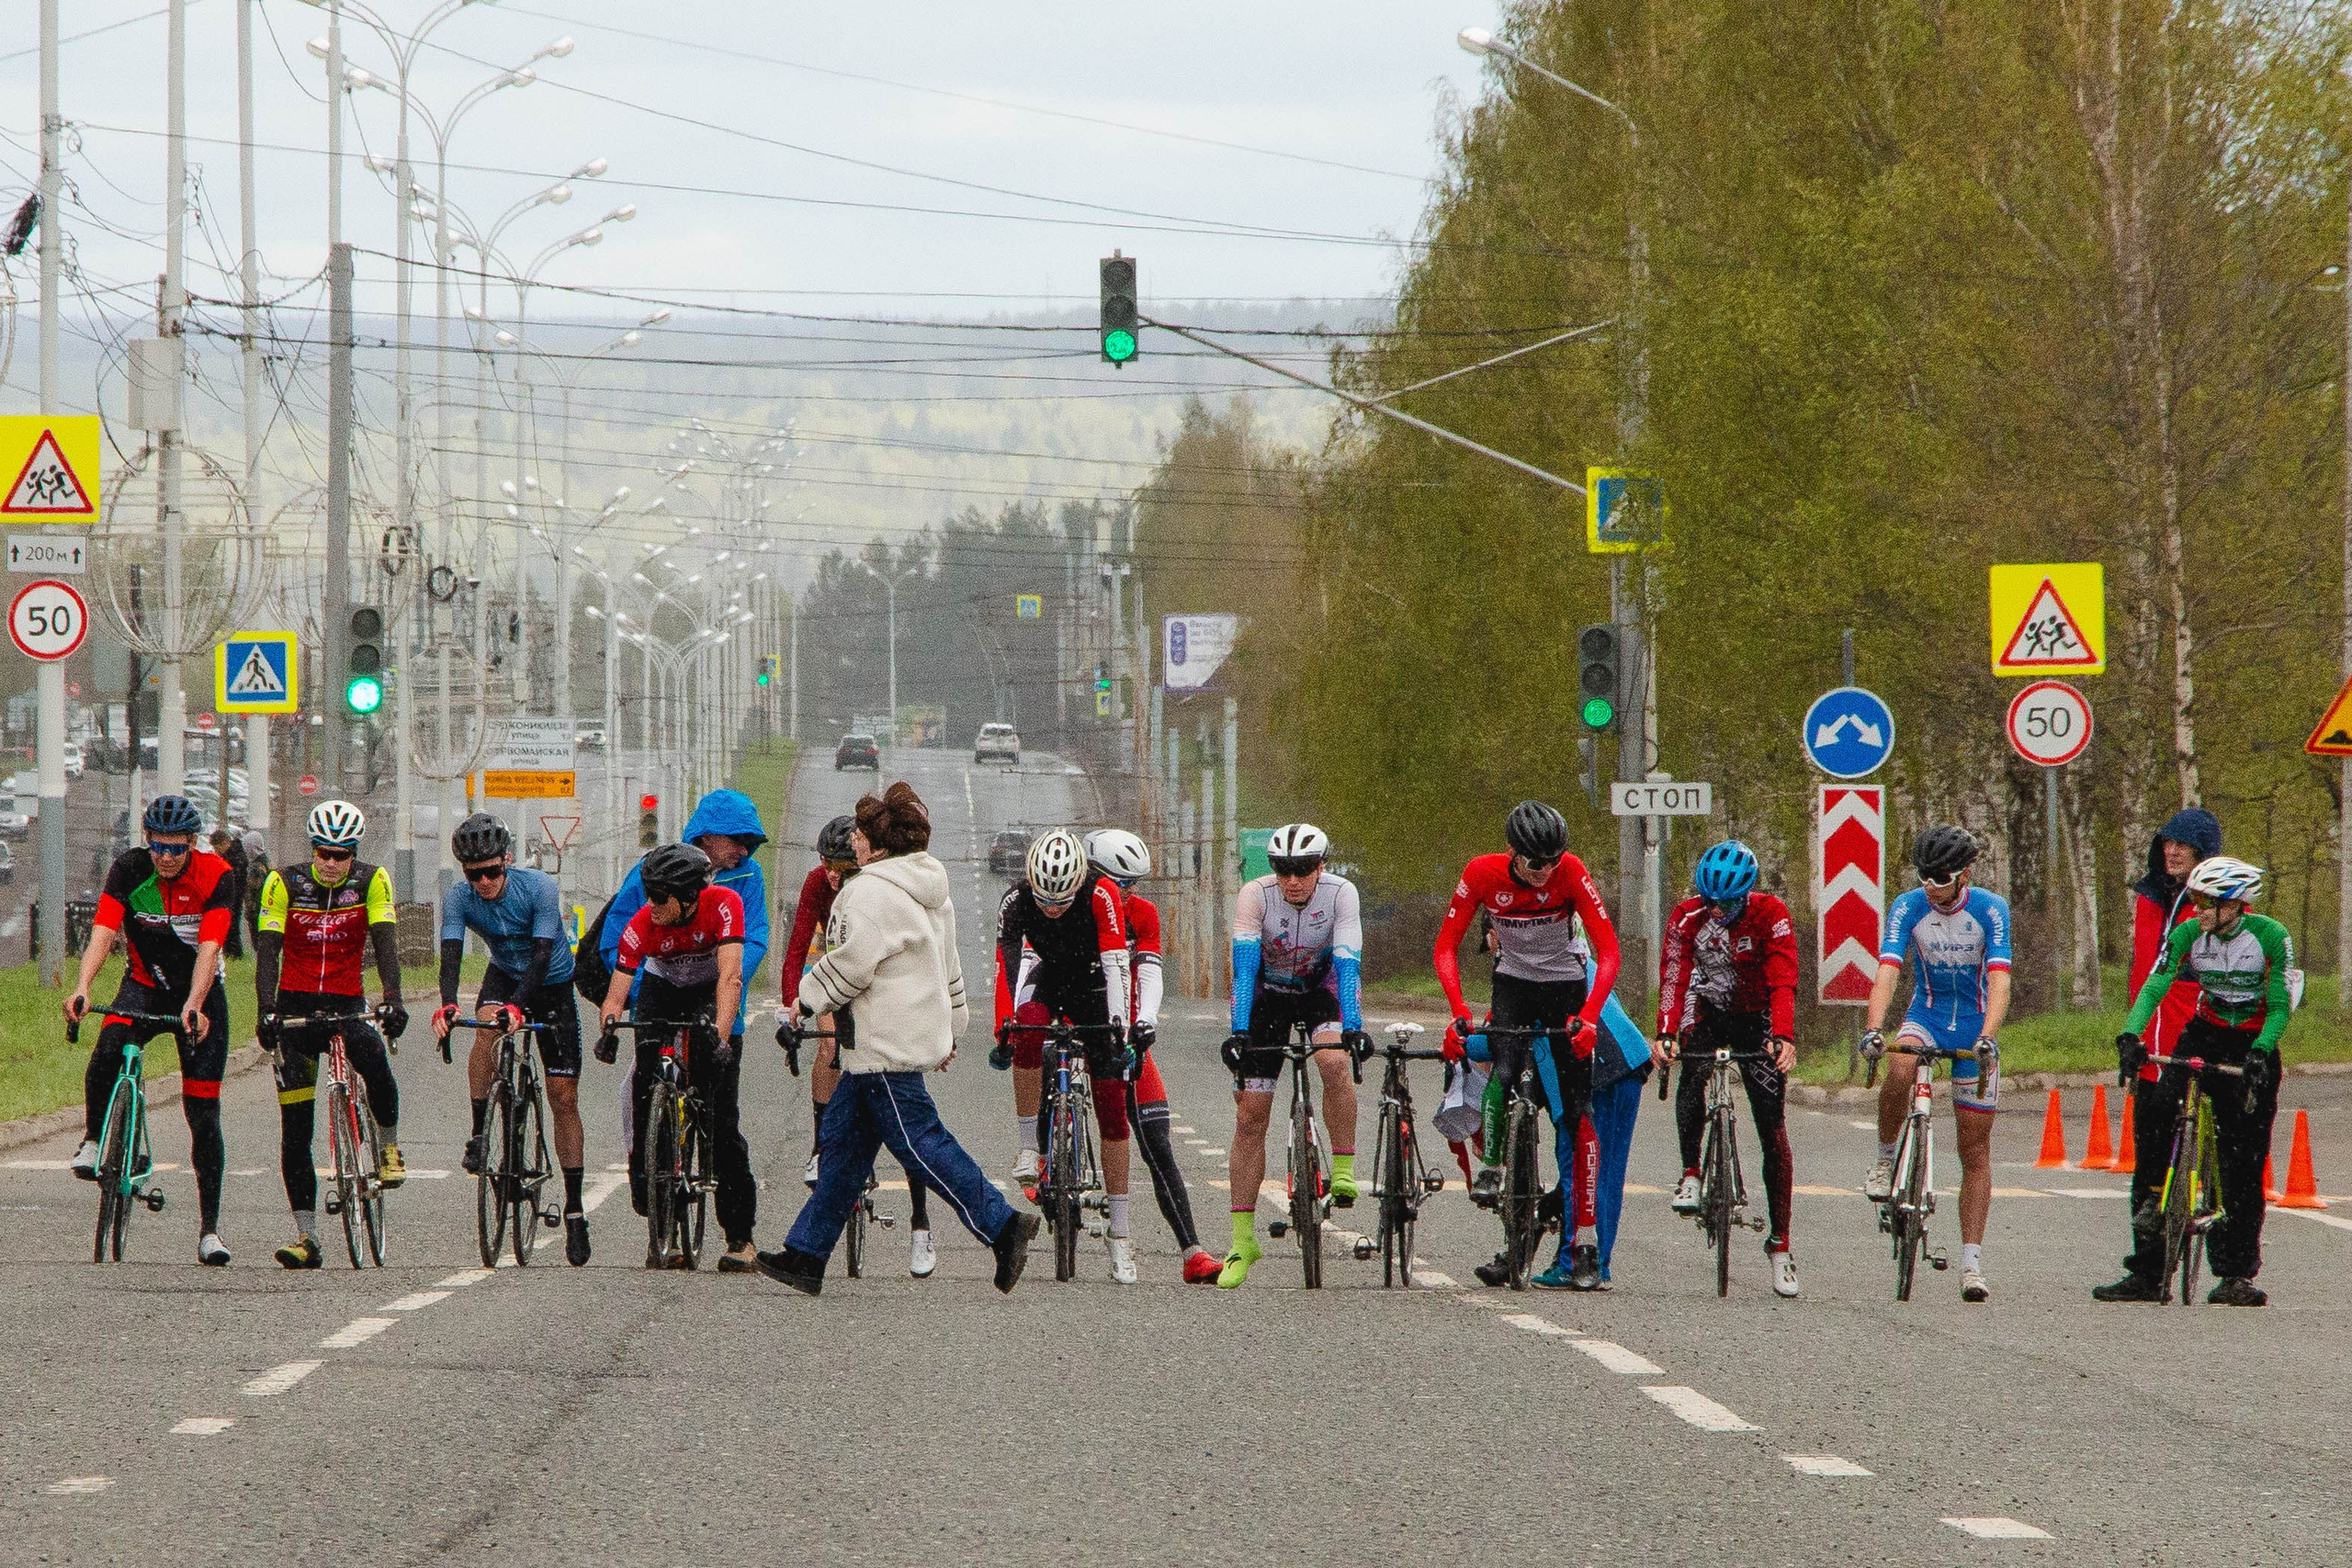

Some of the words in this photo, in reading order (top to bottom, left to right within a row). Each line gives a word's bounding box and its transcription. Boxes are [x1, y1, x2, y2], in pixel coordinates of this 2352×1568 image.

[28, 605, 70, 636] 50
[2027, 706, 2071, 738] 50
[1624, 788, 1700, 809] СТОП
[1093, 886, 1120, 935] ORMAT
[1585, 1140, 1598, 1216] FORMAT
